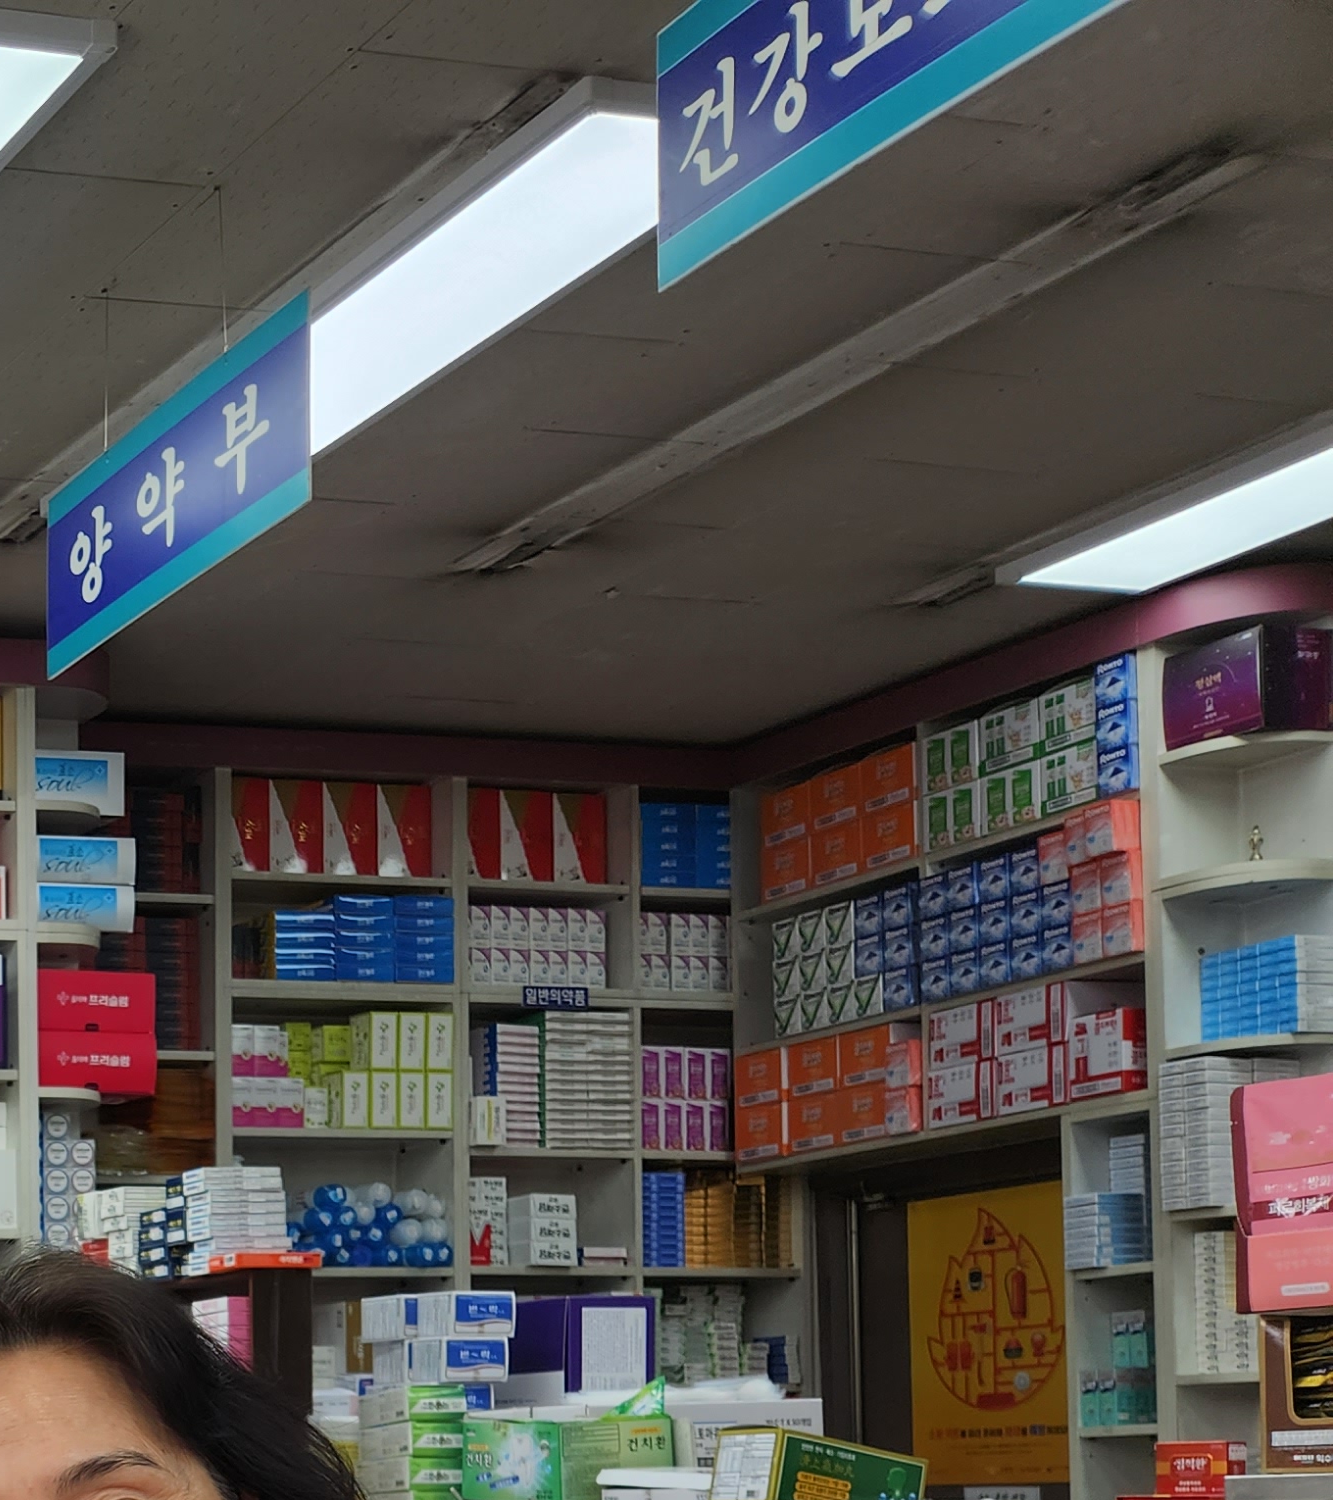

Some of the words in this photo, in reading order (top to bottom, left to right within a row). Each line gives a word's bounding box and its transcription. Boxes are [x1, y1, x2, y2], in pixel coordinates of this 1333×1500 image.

[680, 0, 939, 186] 건강보
[525, 988, 586, 1007] 일반의약품
[627, 1436, 665, 1452] 건치환
[466, 1453, 493, 1466] 건치환
